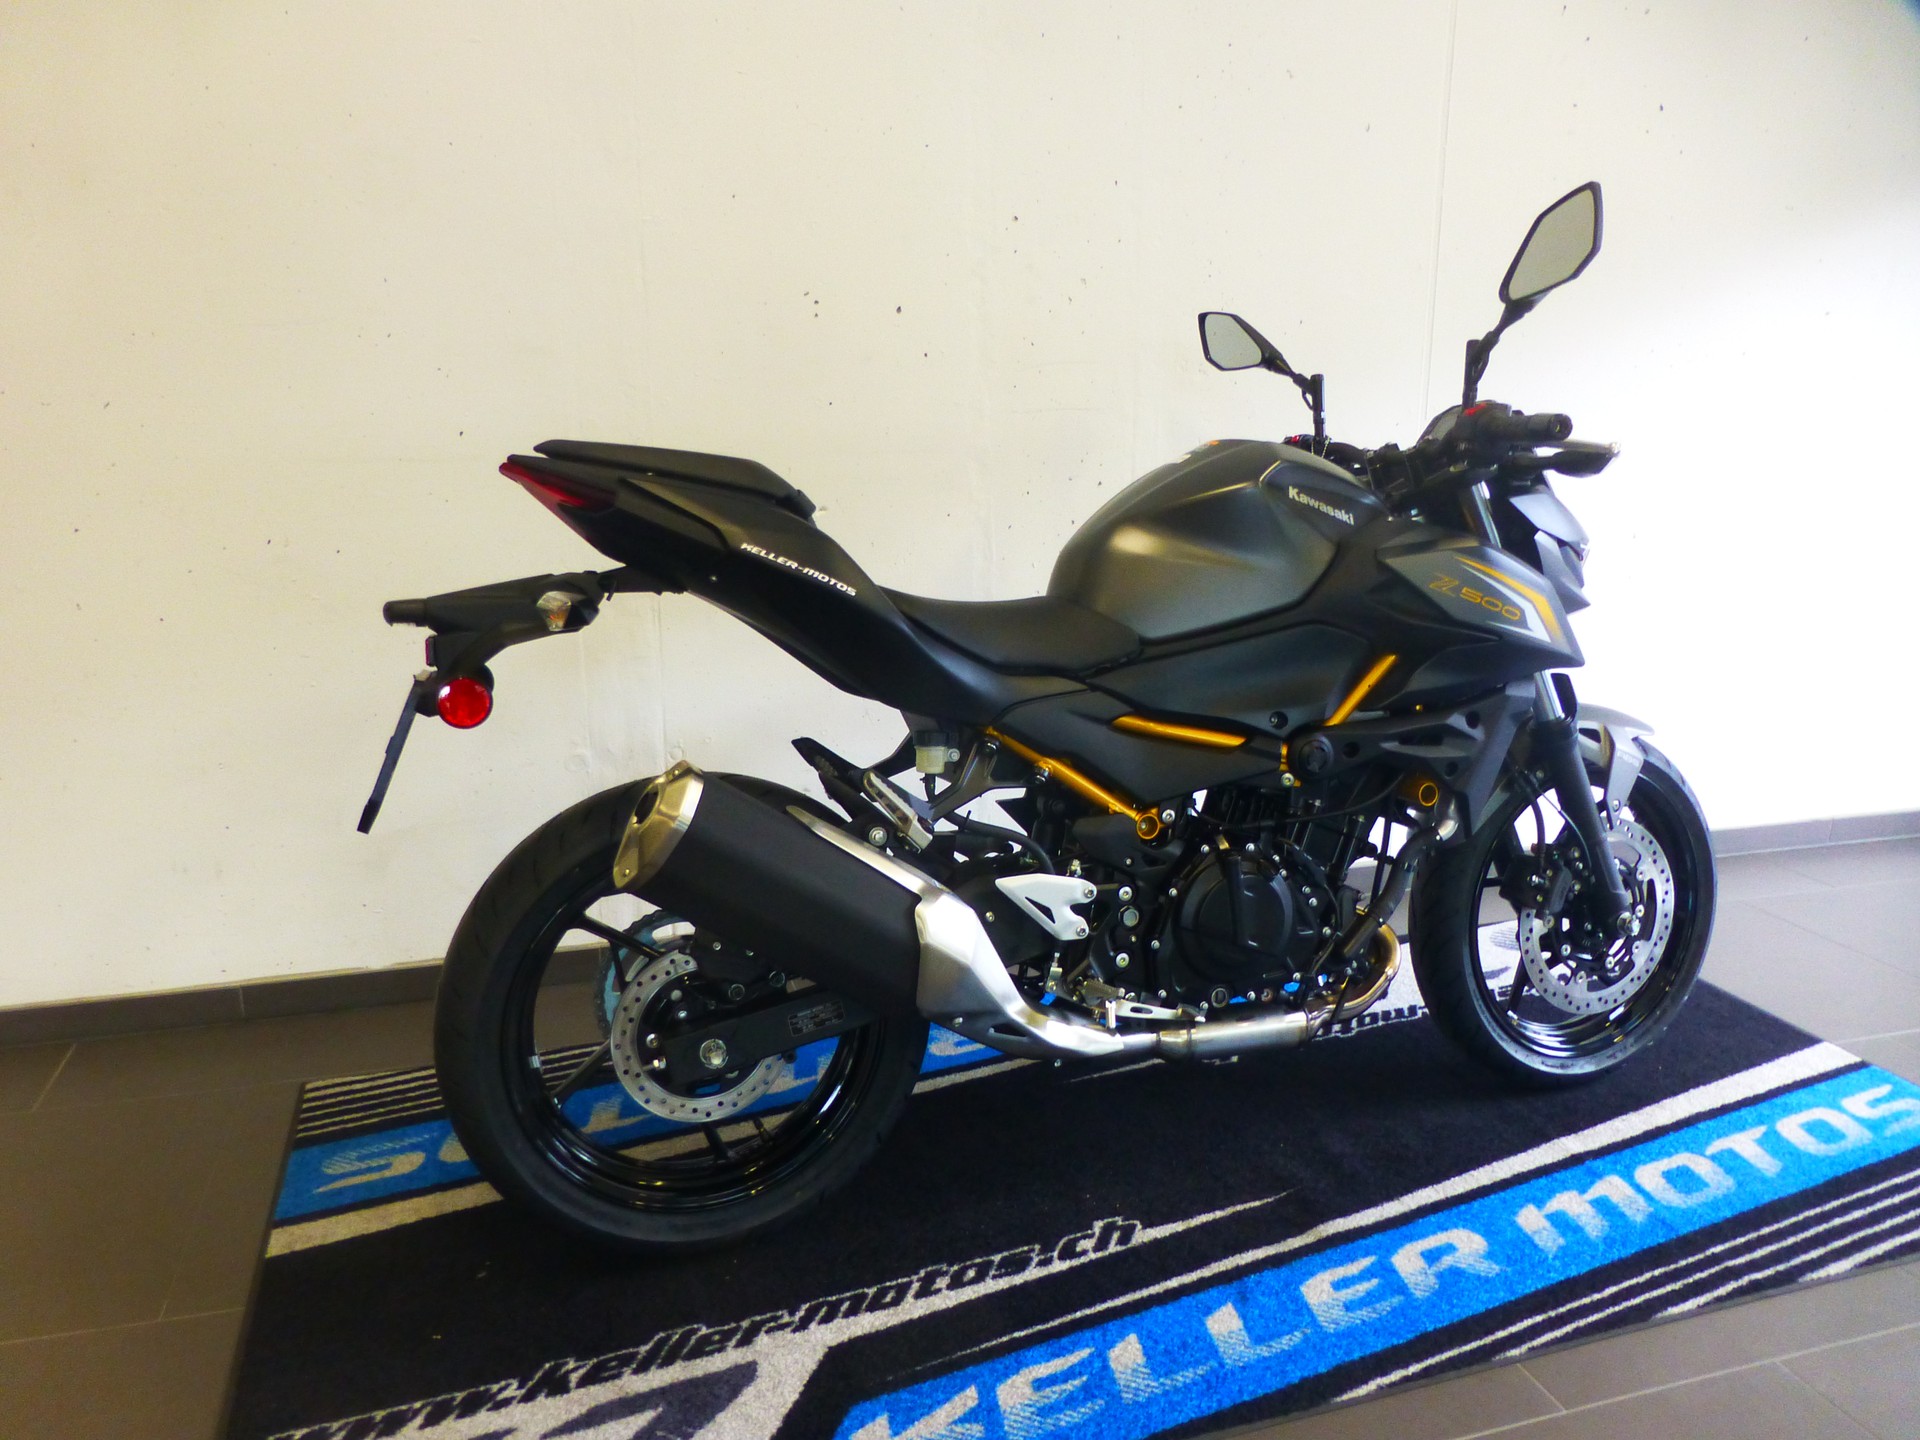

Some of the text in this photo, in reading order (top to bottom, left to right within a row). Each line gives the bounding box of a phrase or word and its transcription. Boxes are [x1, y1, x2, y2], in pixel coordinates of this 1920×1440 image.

[1287, 485, 1355, 526] Kawasaki
[740, 542, 857, 597] KELLER-MOTOS
[1460, 586, 1521, 620] 500
